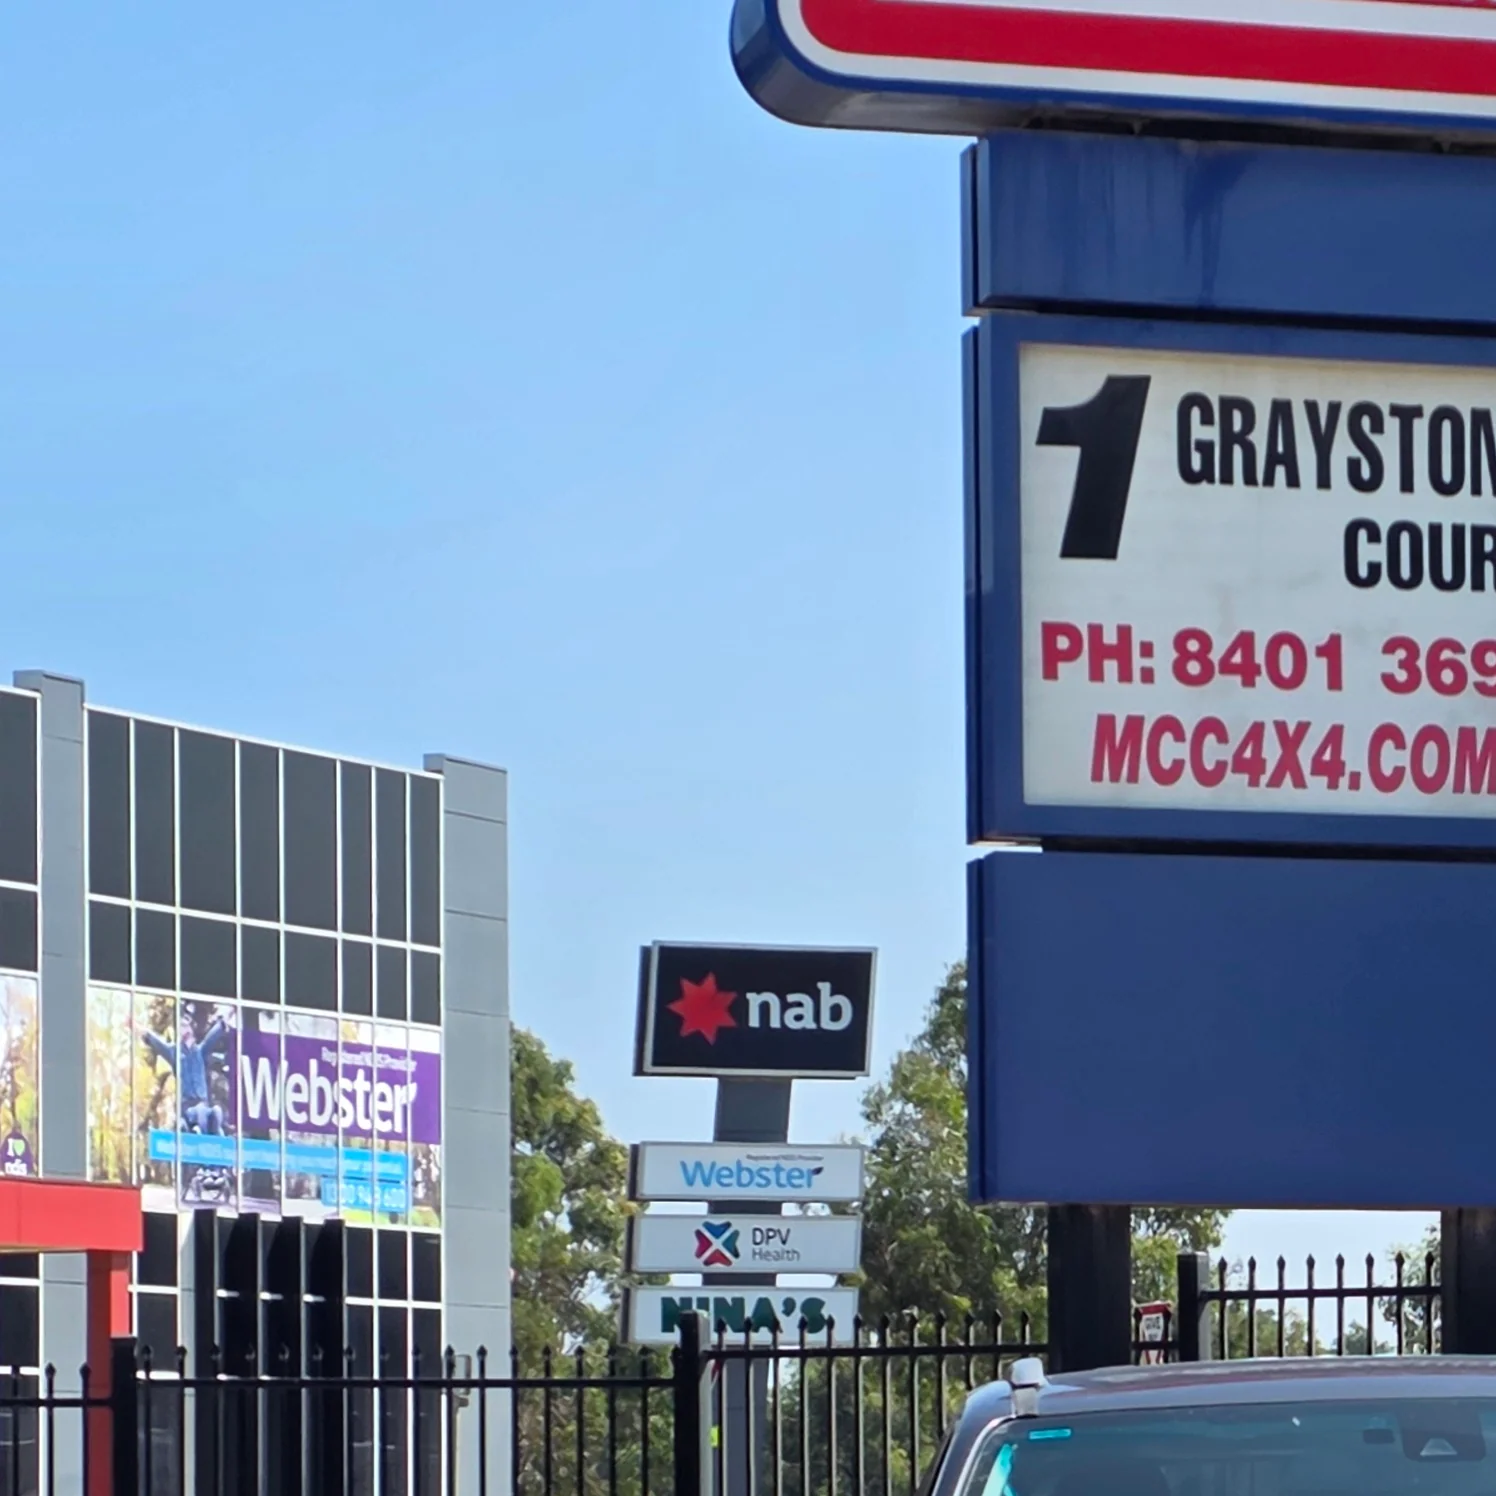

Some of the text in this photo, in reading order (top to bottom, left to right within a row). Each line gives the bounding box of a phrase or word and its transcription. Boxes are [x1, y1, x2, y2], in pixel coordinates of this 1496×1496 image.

[1035, 375, 1151, 560] 1
[1041, 622, 1155, 684] PH:
[1172, 629, 1342, 691] 8401
[746, 982, 853, 1030] nab
[239, 1055, 417, 1133] Webster
[680, 1159, 823, 1188] Webster
[752, 1227, 791, 1246] DPV
[752, 1248, 801, 1262] Health
